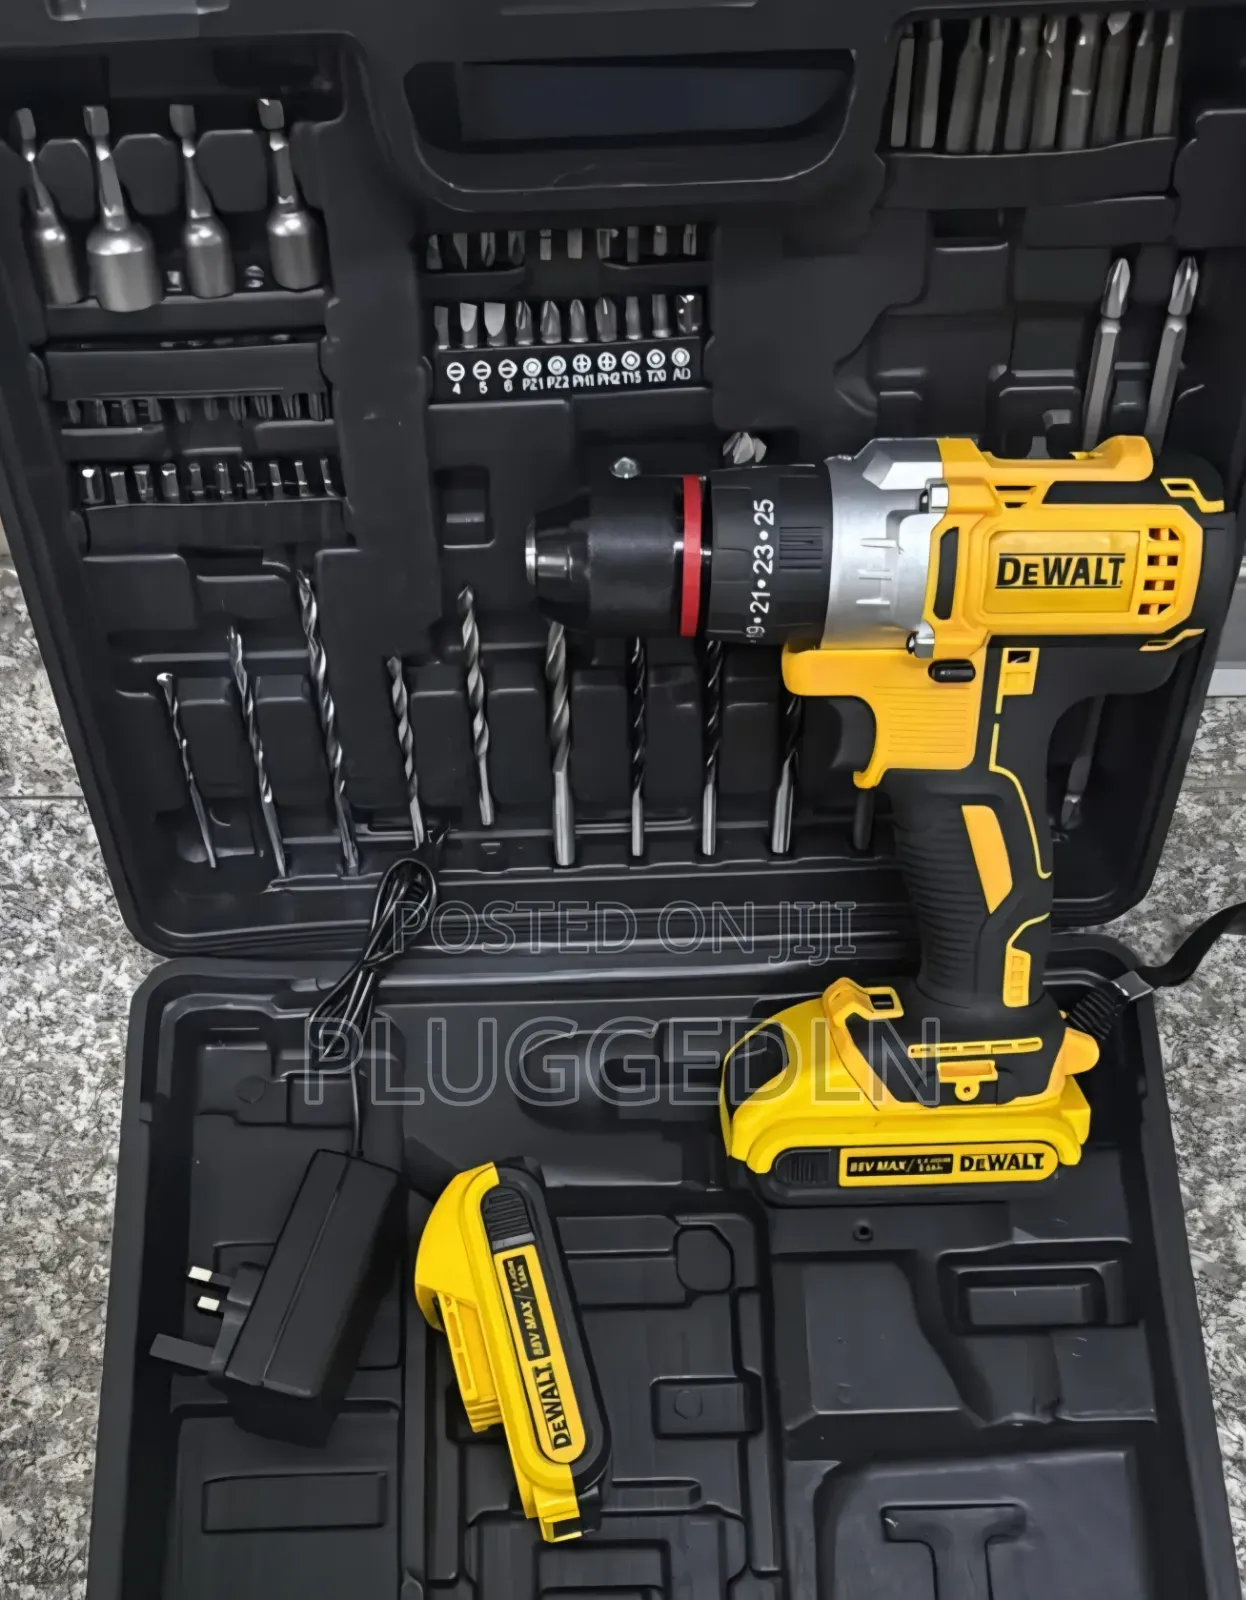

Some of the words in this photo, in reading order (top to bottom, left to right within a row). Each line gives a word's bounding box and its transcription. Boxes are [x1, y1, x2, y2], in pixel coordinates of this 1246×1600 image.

[452, 382, 461, 395] 4
[479, 380, 489, 395] 5
[503, 379, 513, 393] 6
[547, 375, 570, 389] PZ2
[754, 499, 774, 526] 25
[753, 544, 774, 574] 23
[750, 591, 771, 614] 21
